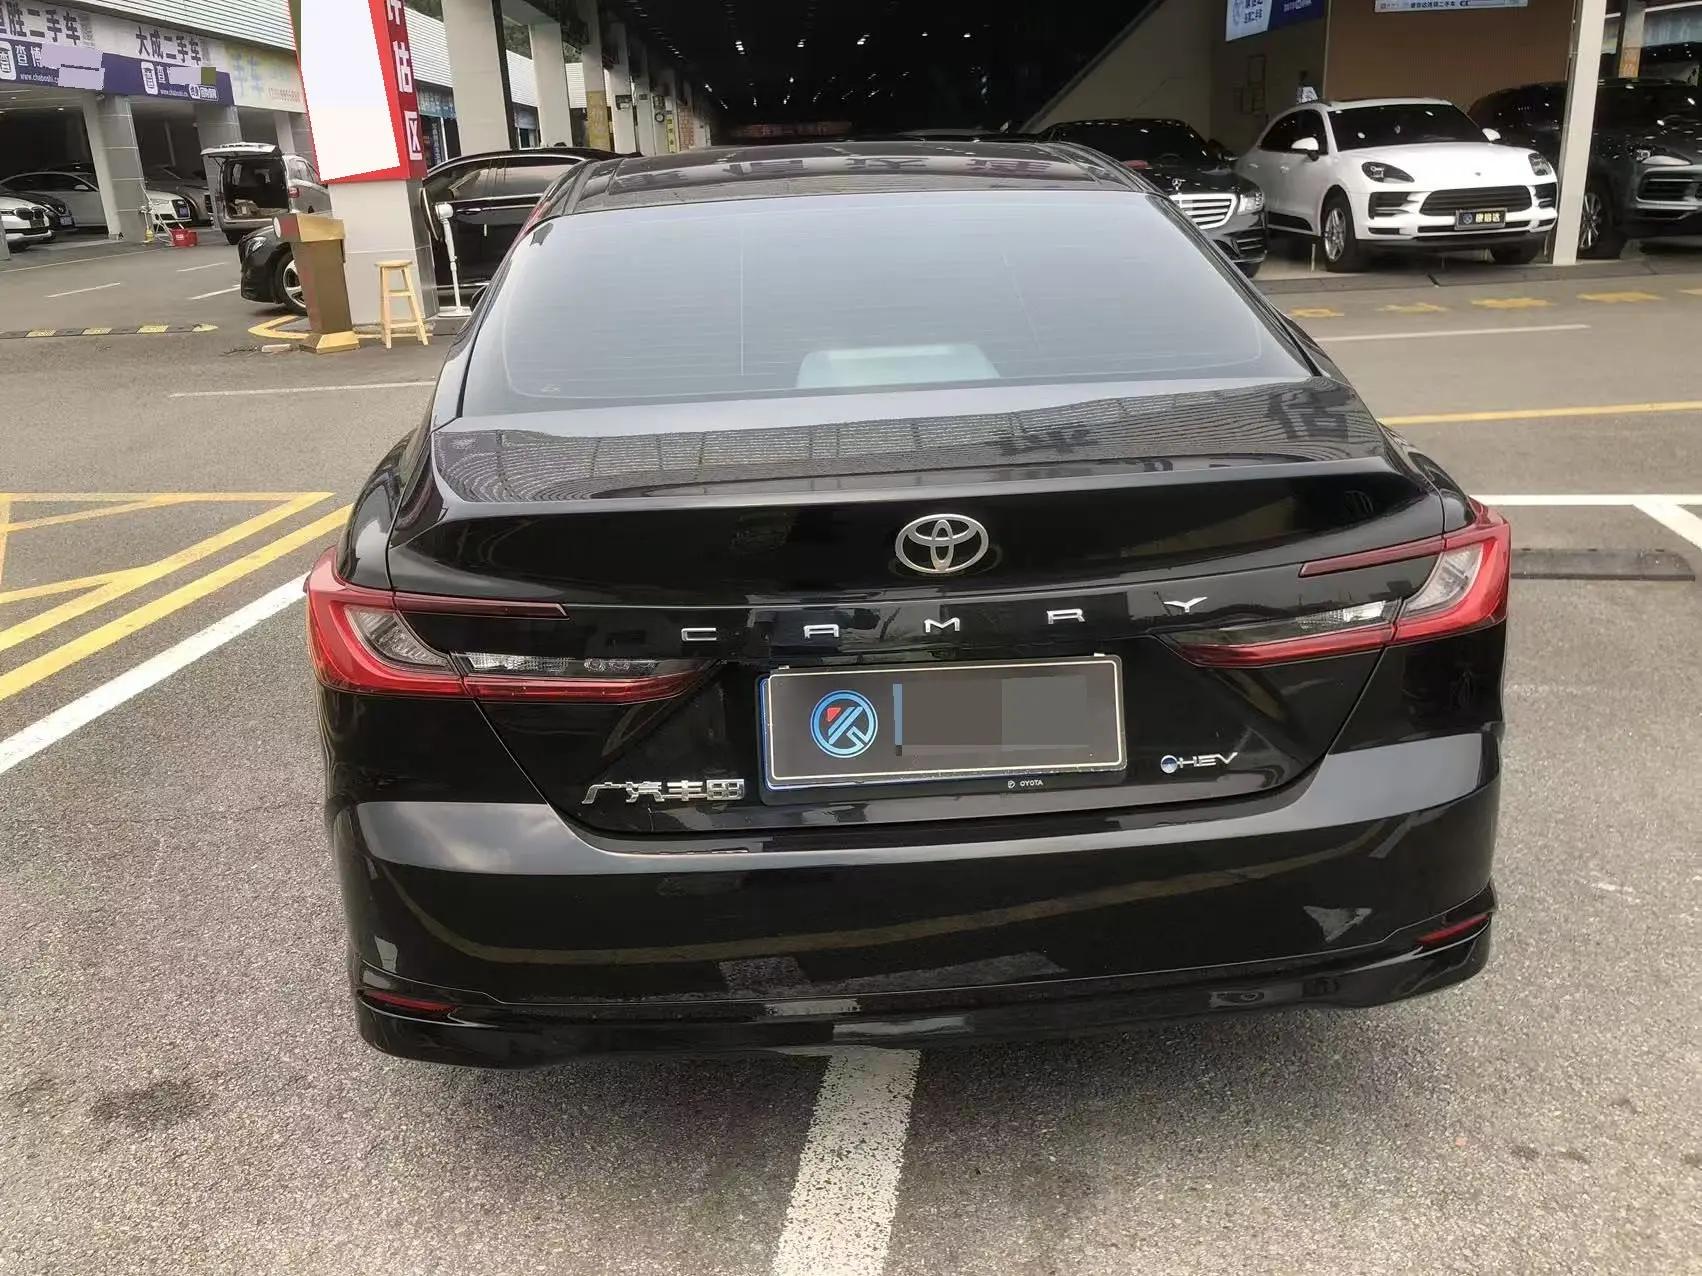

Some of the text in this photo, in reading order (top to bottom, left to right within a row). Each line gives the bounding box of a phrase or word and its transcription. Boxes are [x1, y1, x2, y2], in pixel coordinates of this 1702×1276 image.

[135, 26, 202, 66] 大成二手车
[680, 596, 1208, 643] CAMRY
[581, 778, 745, 806] 广汽丰田
